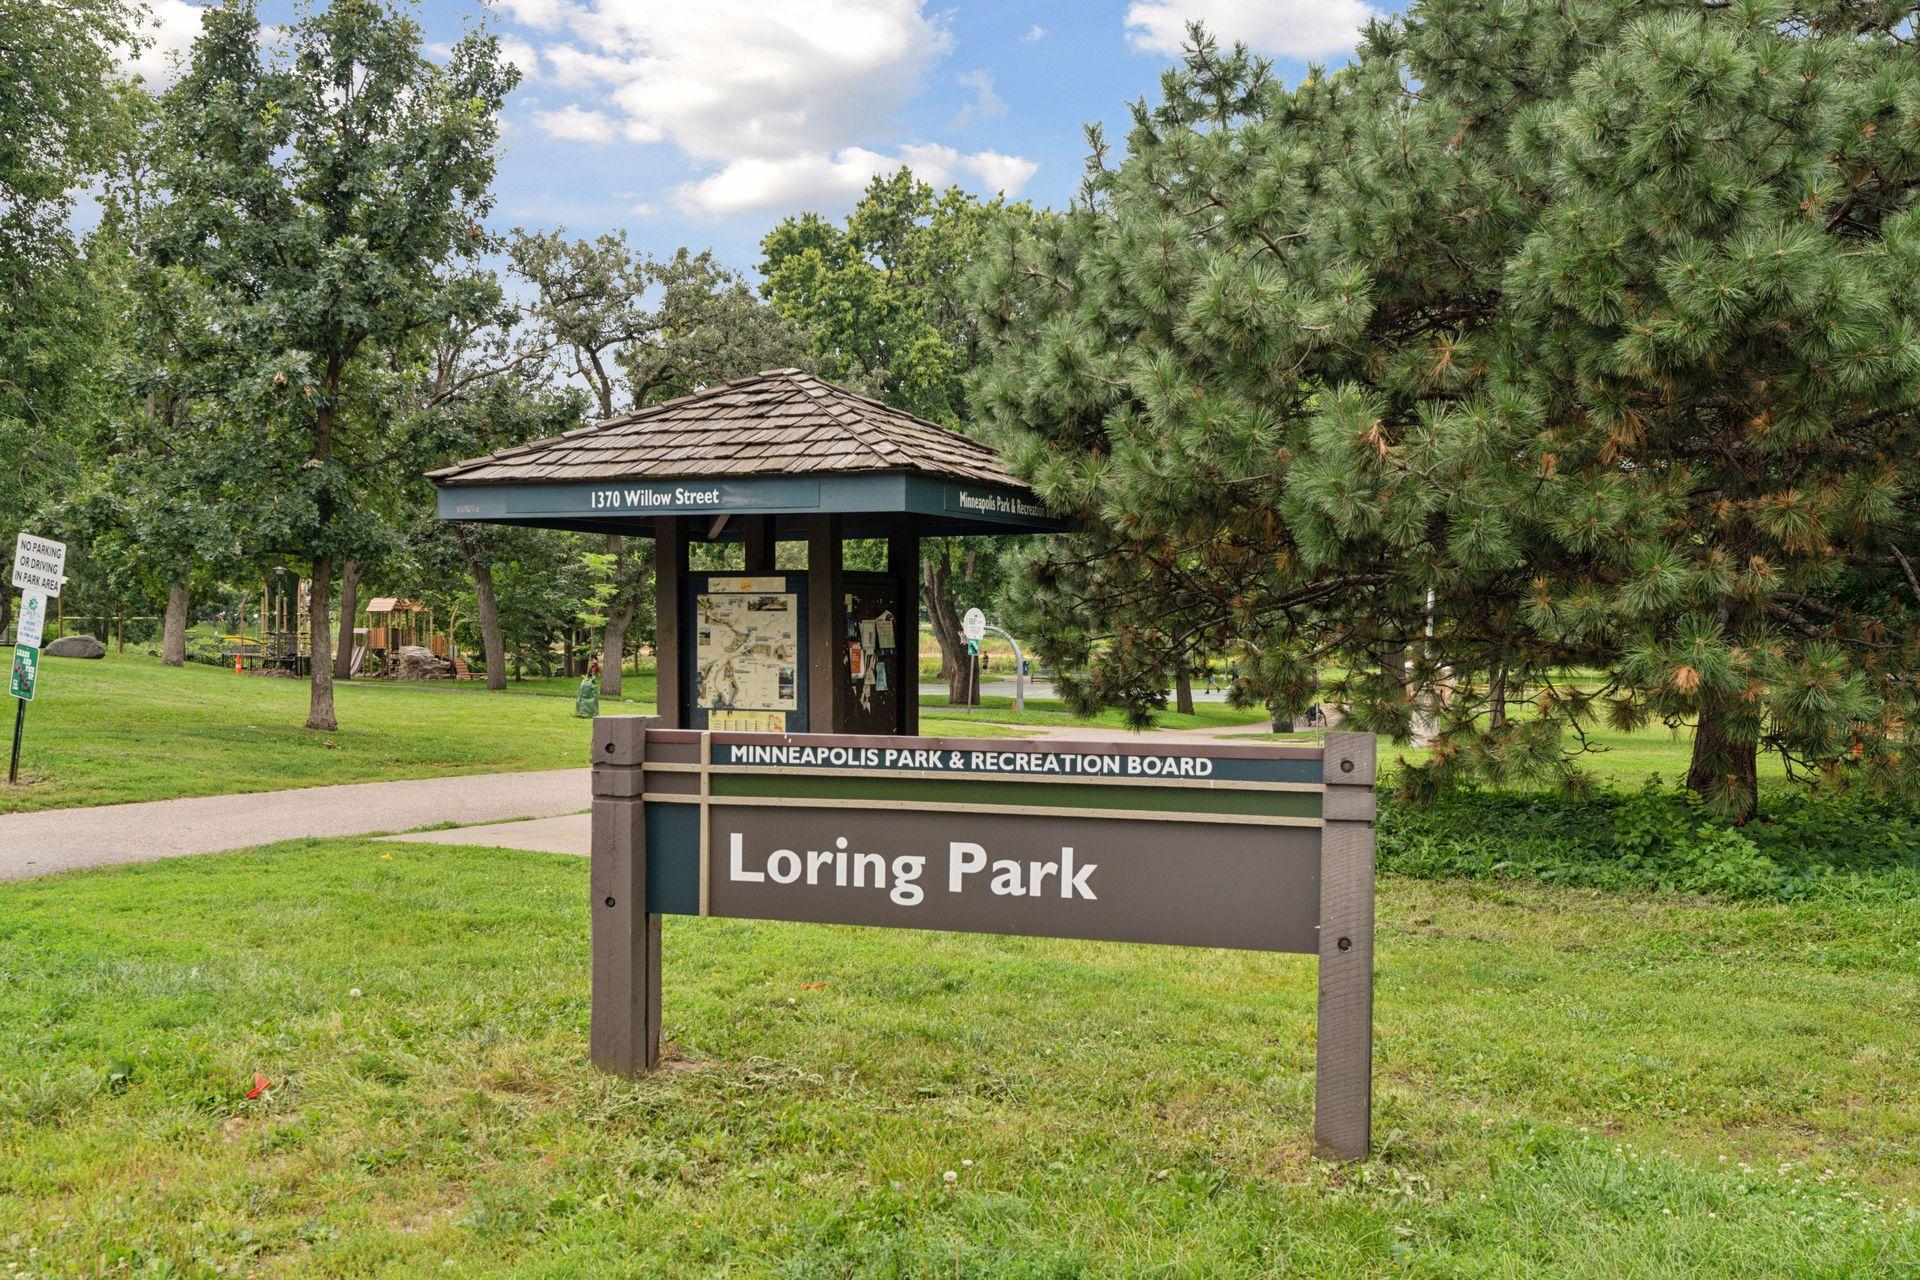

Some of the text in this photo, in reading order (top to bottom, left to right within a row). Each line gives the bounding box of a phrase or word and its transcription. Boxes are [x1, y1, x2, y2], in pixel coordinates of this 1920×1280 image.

[591, 488, 719, 508] 1370 Willow Street
[959, 490, 996, 514] Minneapolis
[996, 496, 1010, 513] Park
[1011, 498, 1016, 513] &
[21, 540, 62, 559] NO PARKING
[20, 556, 58, 574] OR DRIVING
[15, 570, 58, 591] IN PARK AREA
[731, 745, 1213, 777] MINNEAPOLIS PARK & RECREATION BOARD
[731, 833, 1097, 905] Loring Park
